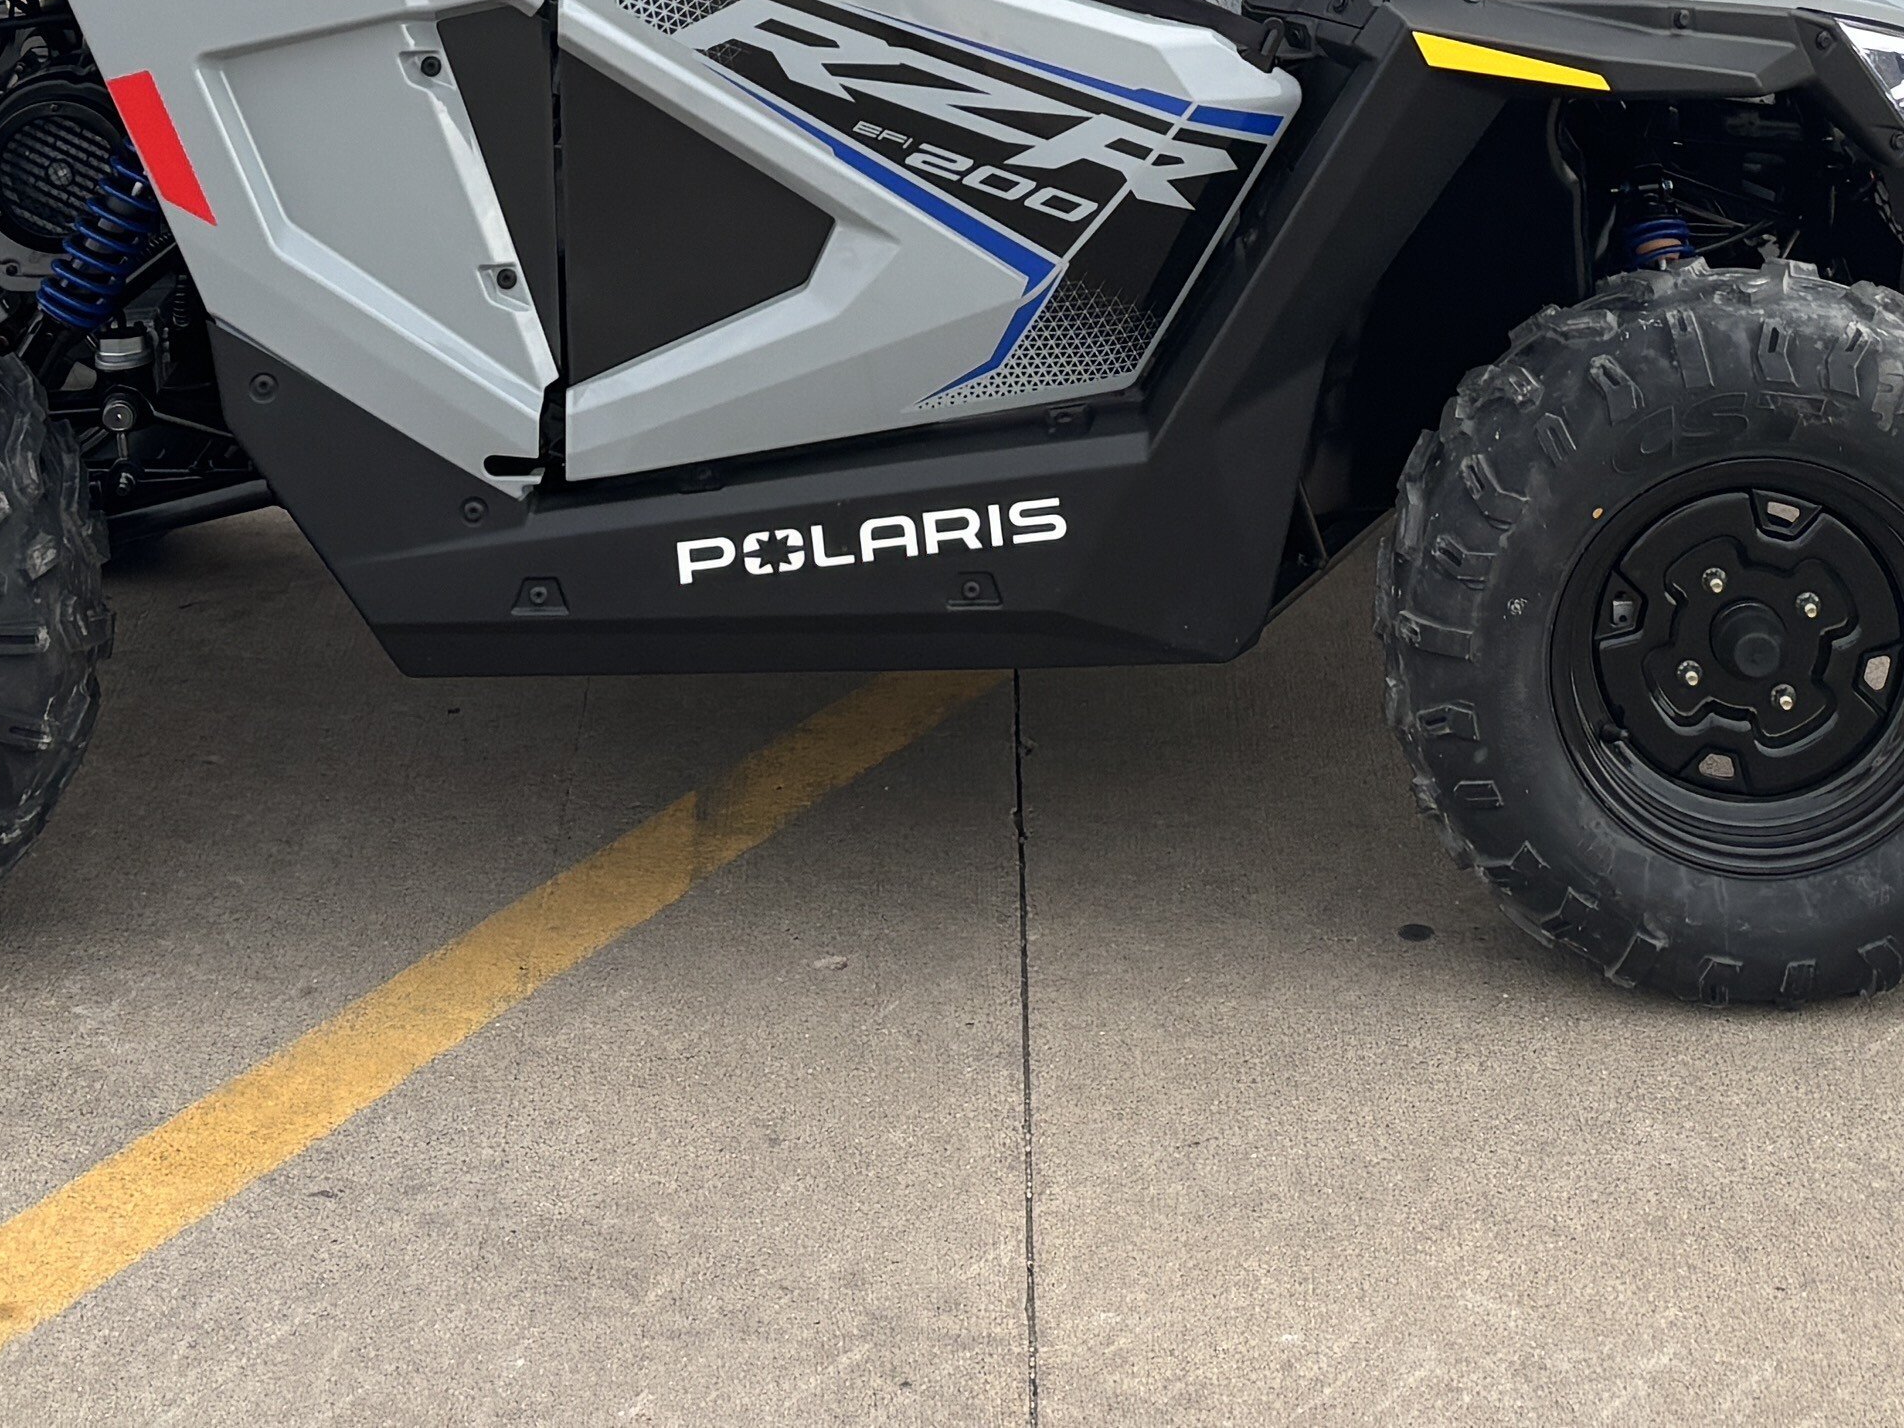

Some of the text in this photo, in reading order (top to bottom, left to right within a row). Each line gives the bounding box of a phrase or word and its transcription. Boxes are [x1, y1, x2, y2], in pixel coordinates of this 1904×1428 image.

[852, 120, 1099, 222] EFI 200
[676, 496, 1067, 585] POLARIS
